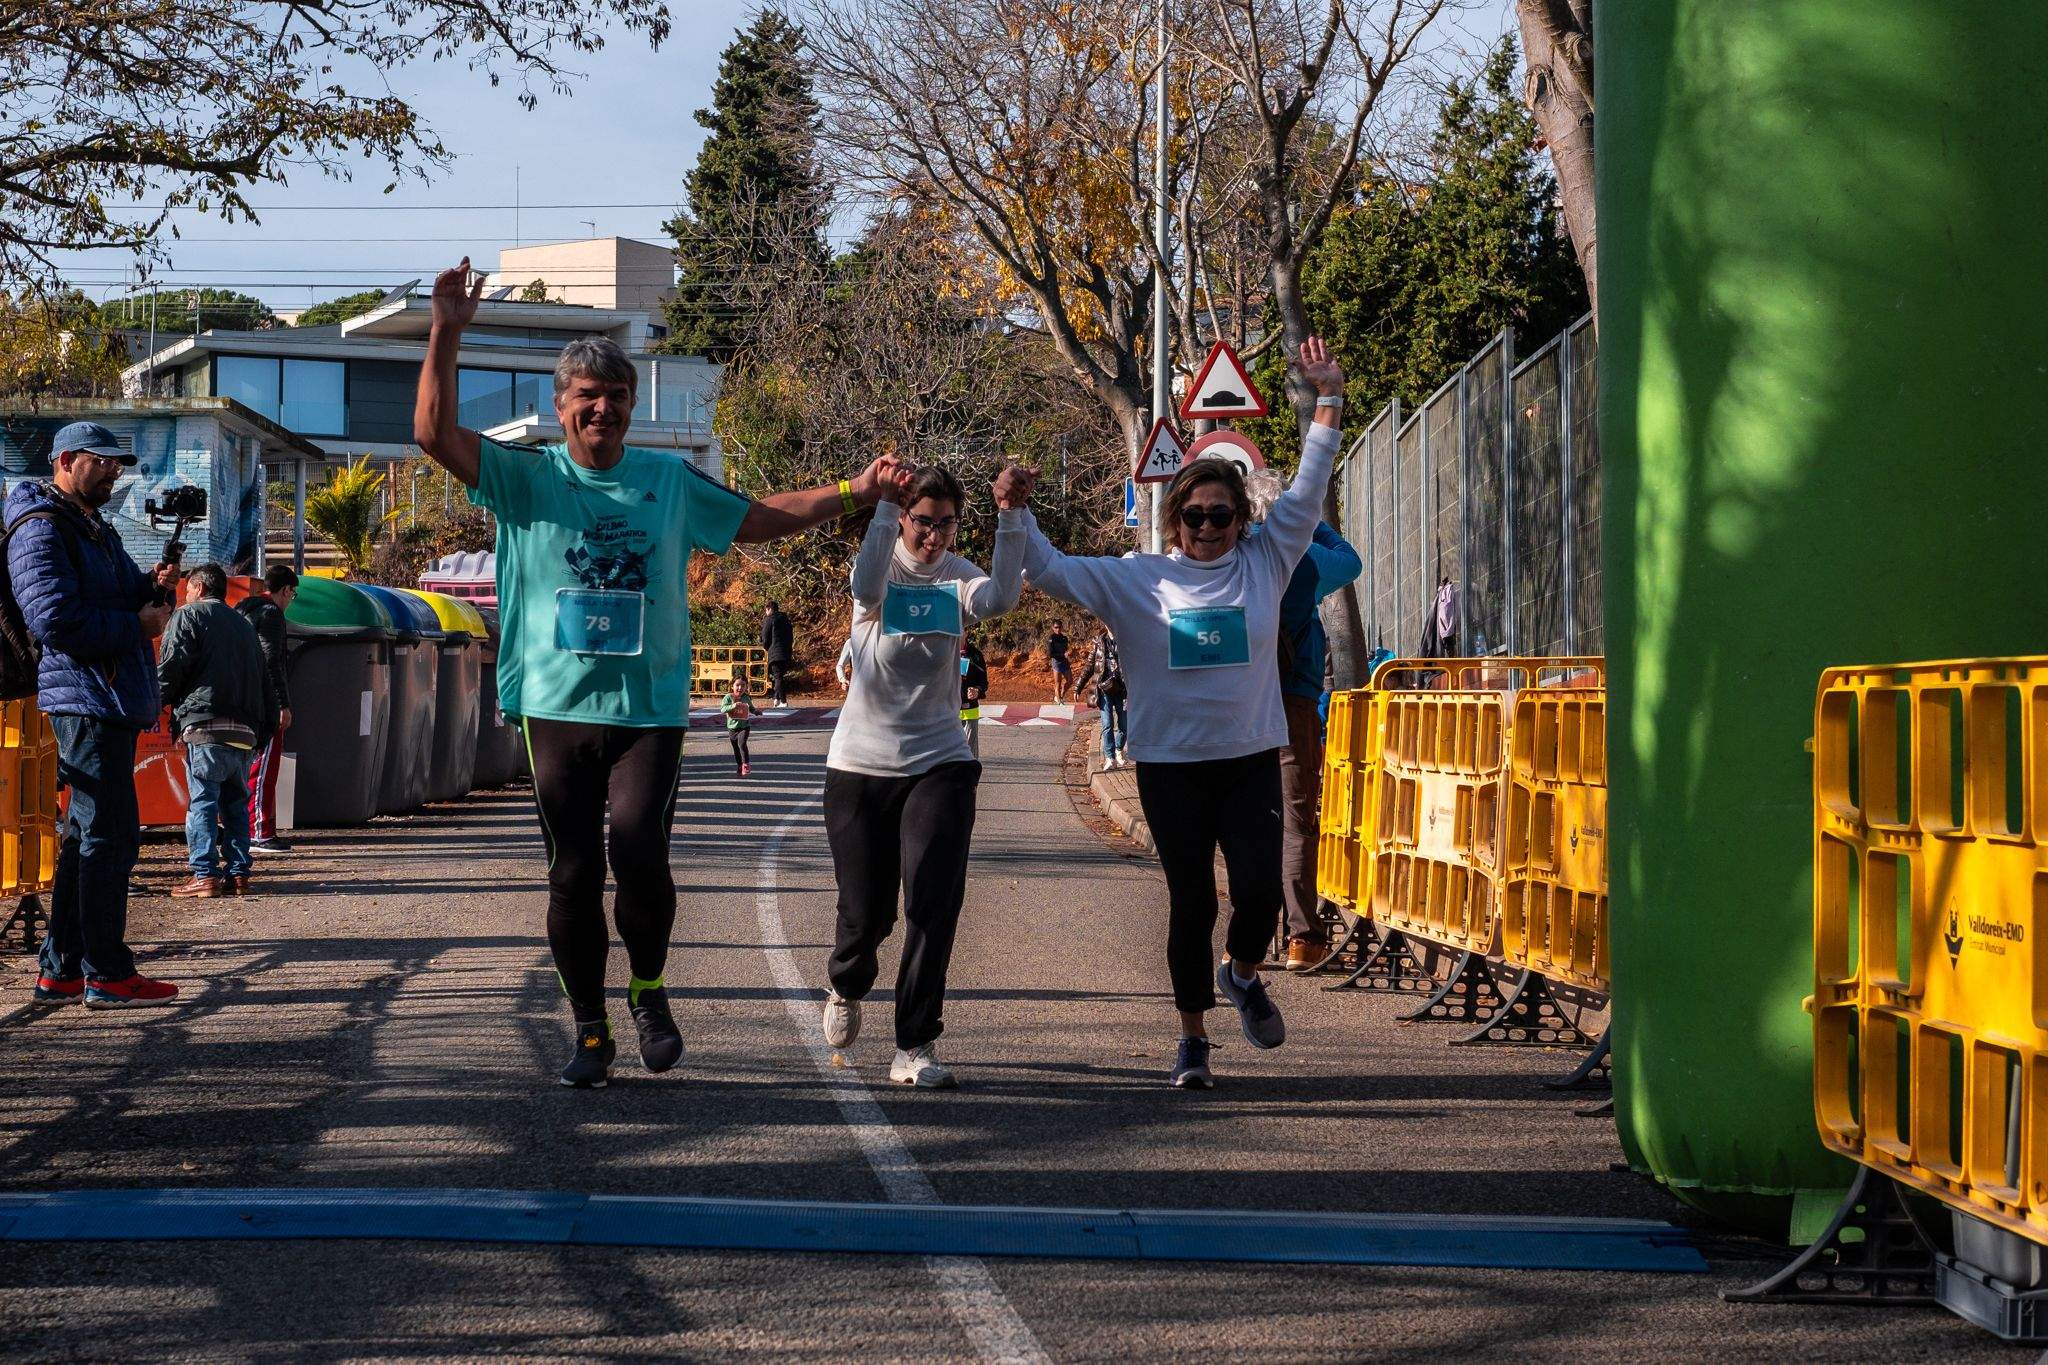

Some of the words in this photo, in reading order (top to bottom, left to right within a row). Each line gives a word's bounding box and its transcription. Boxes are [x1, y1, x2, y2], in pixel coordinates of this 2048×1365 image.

[908, 604, 932, 617] 97
[585, 616, 610, 631] 78
[1197, 630, 1221, 646] 56
[1968, 914, 2024, 942] Valldoreix-EMD
